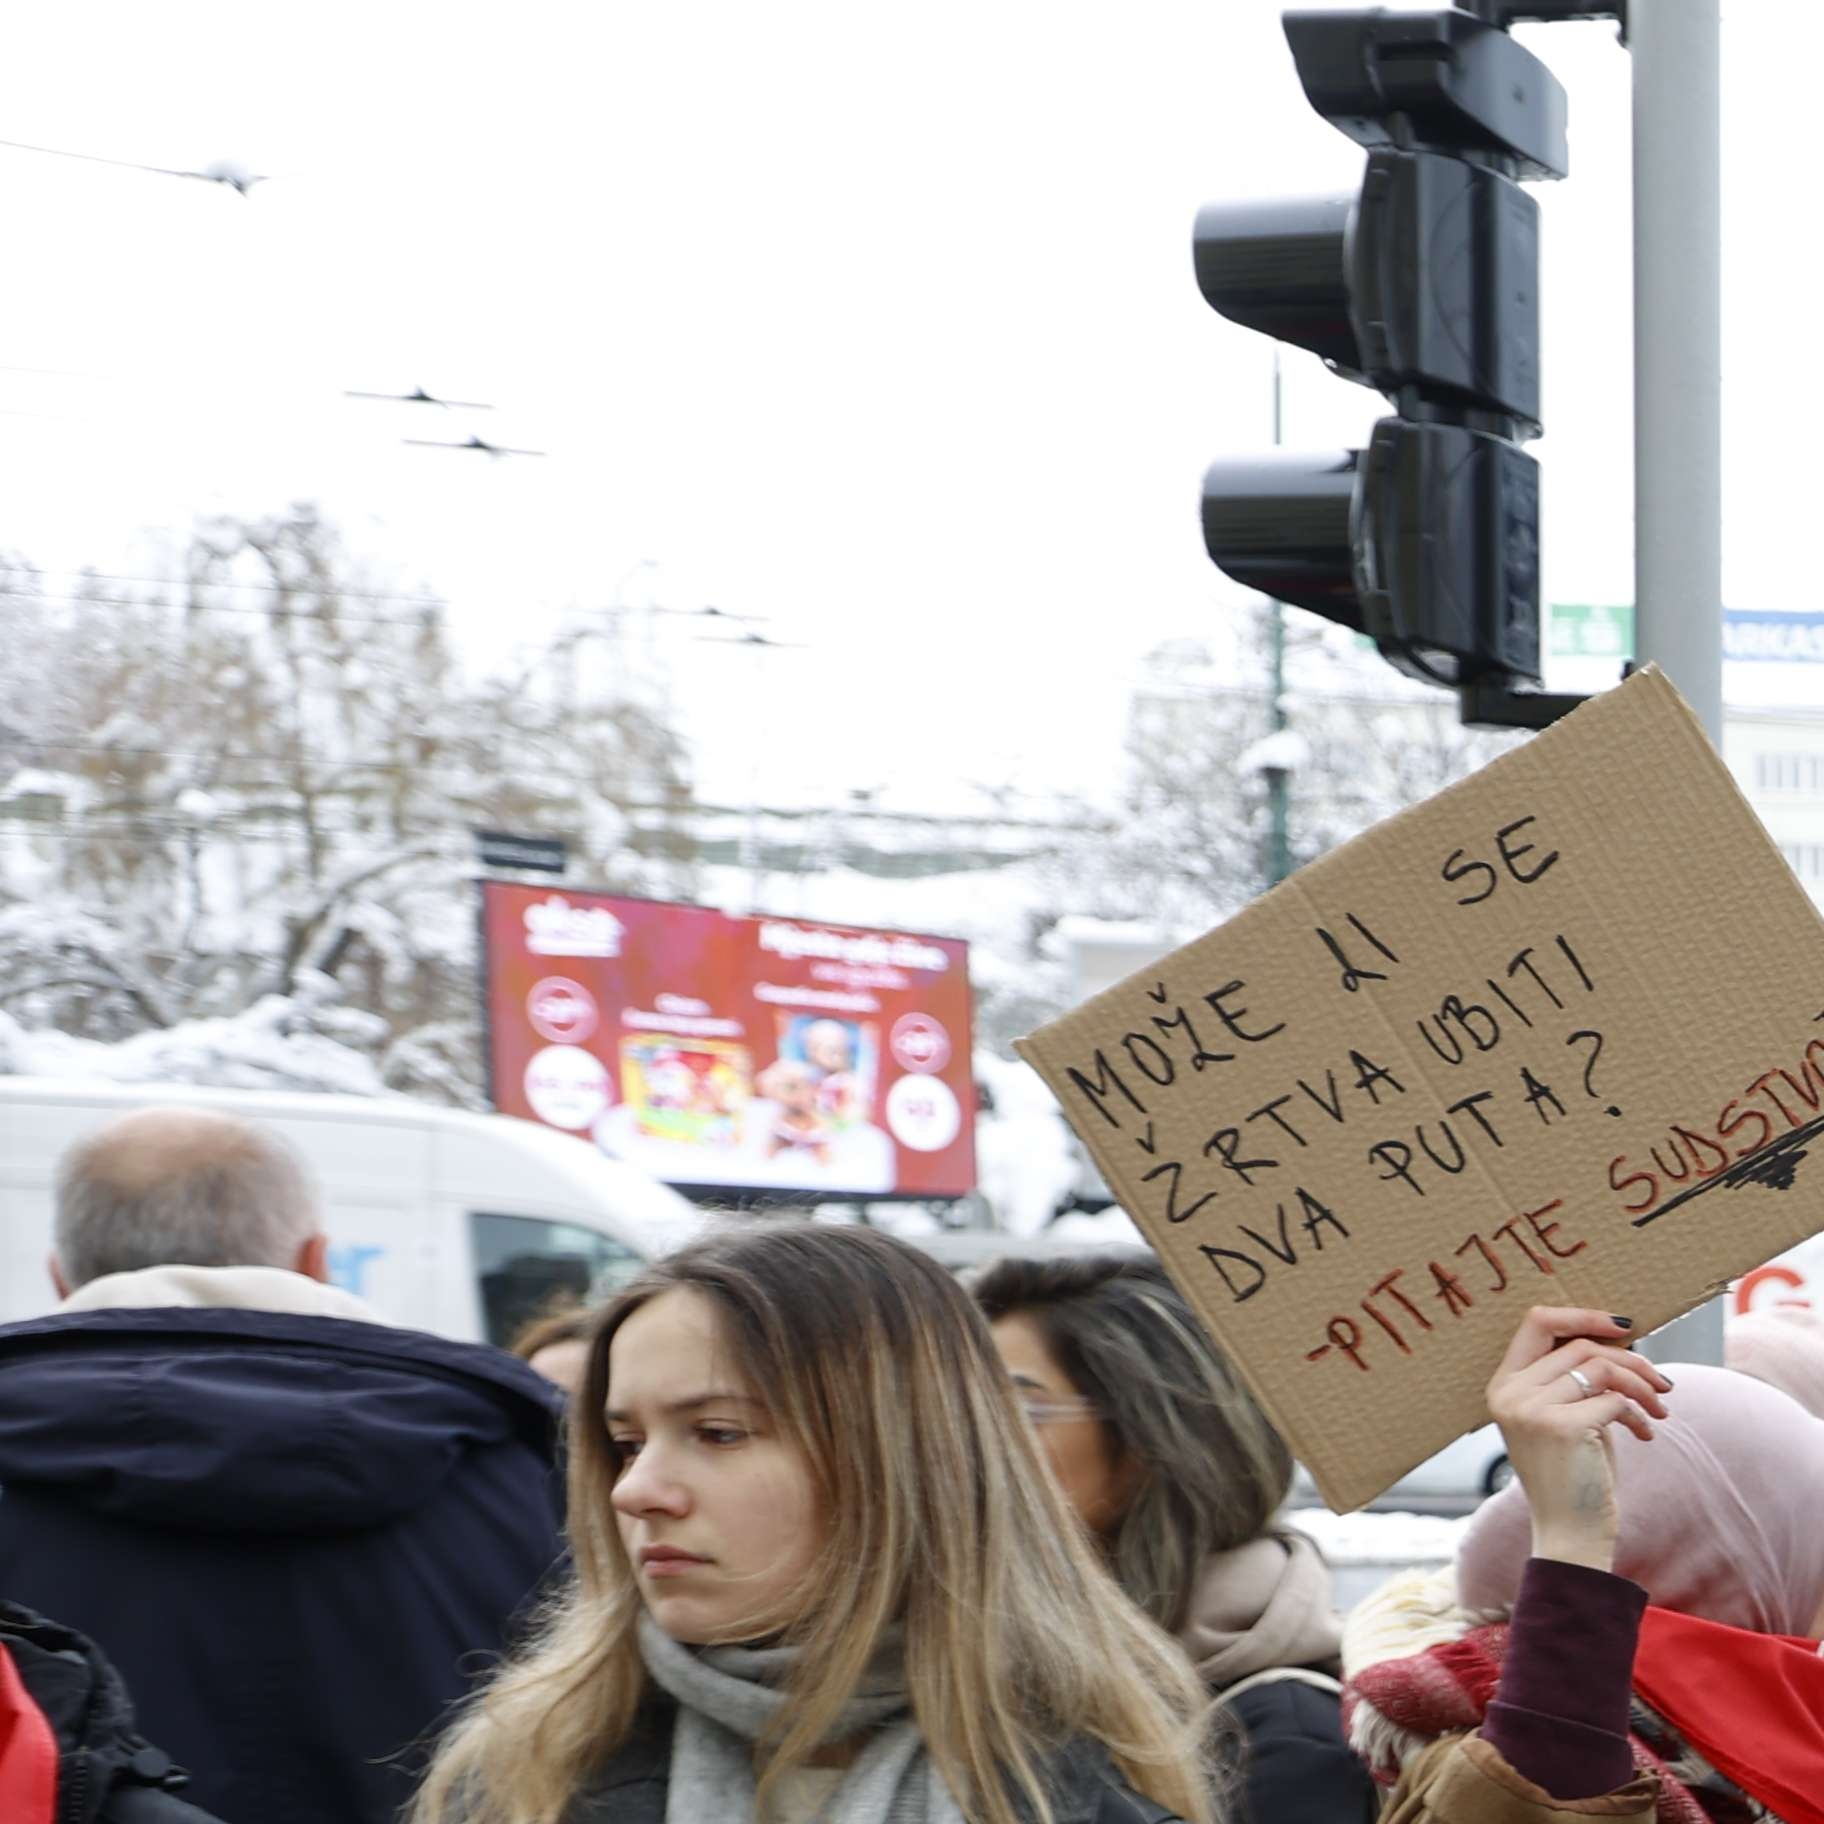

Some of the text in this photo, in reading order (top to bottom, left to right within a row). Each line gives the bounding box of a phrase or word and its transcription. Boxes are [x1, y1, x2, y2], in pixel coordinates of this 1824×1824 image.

[1065, 814, 1561, 1129] MOŽE LI SE
[1134, 934, 1597, 1225] ŽRTVA UBITI
[1199, 1186, 1350, 1303] DVA
